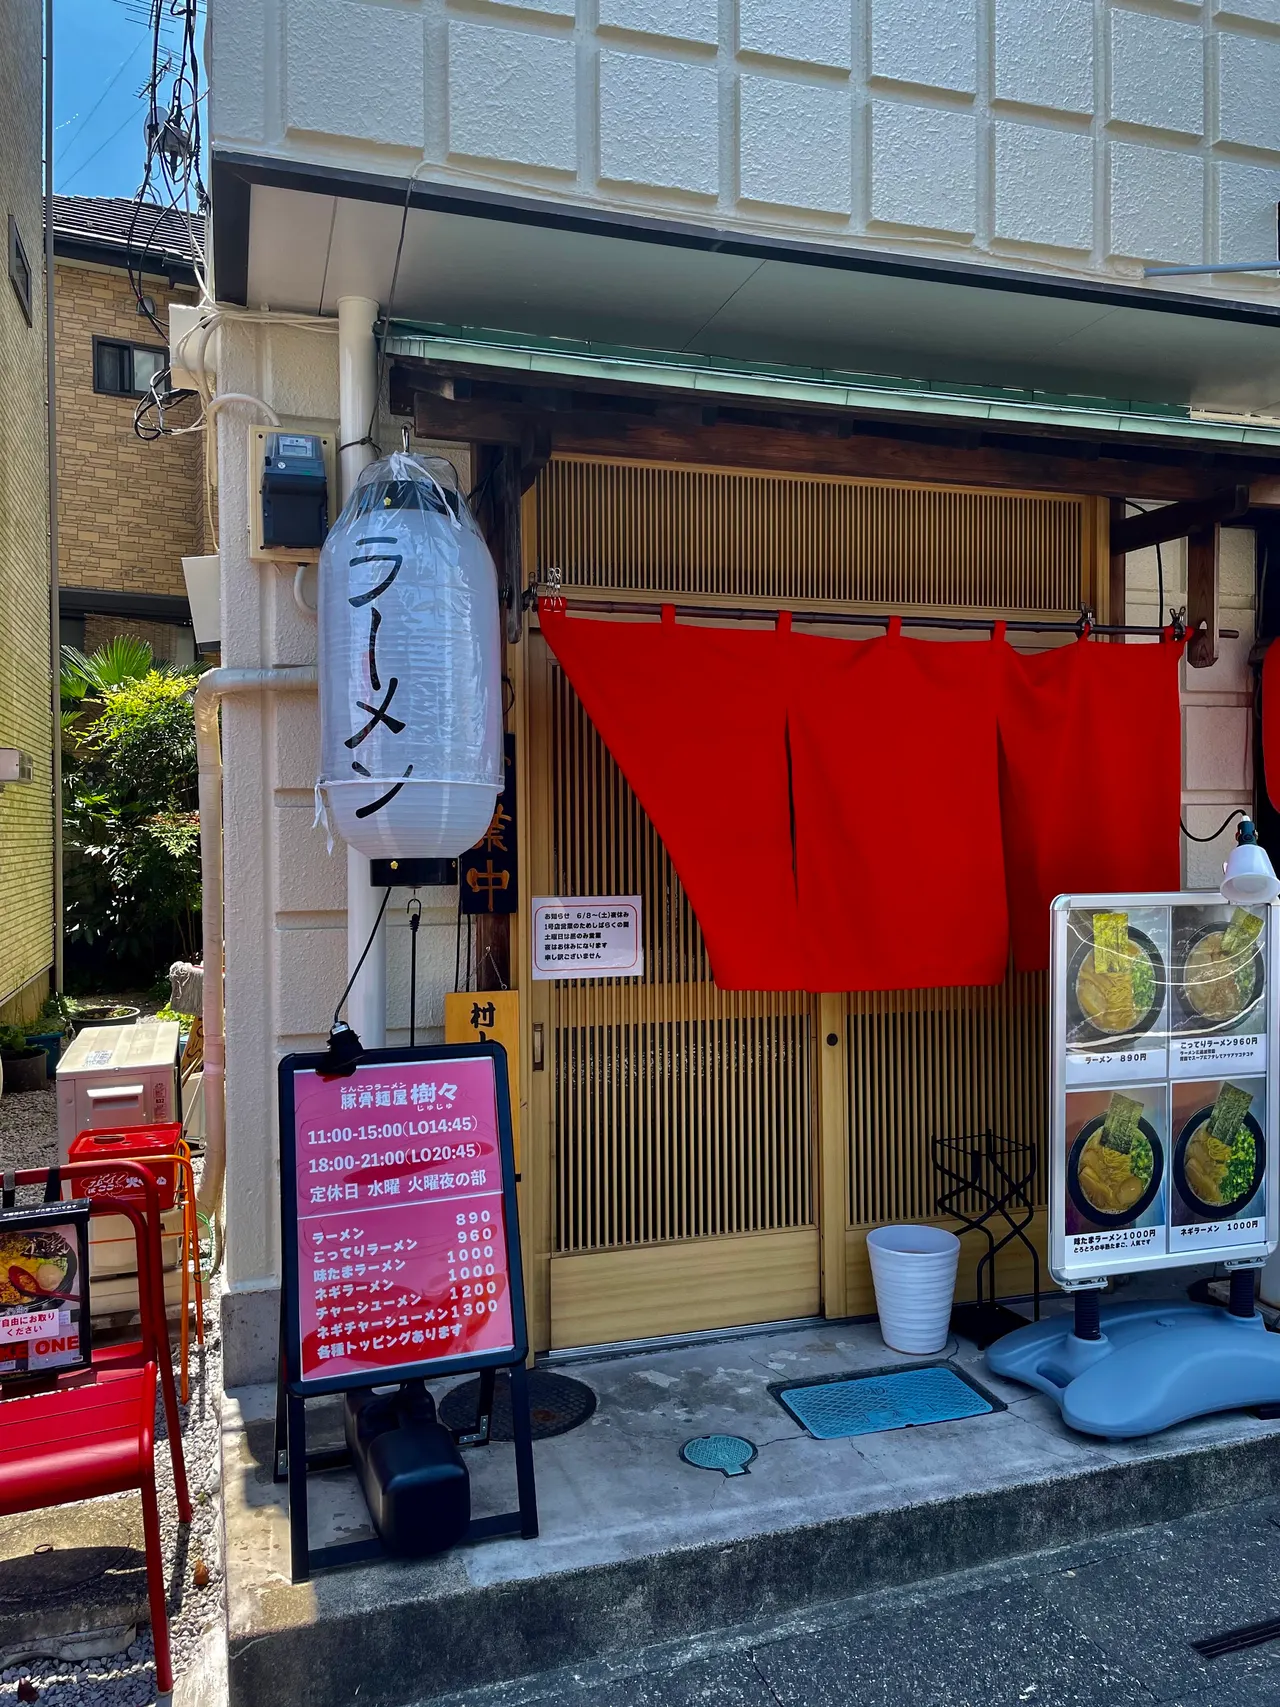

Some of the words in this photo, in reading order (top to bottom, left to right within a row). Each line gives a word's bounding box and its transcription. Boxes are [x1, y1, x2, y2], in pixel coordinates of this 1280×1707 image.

[344, 536, 413, 819] ラーメン
[465, 757, 513, 913] 業中
[544, 912, 570, 920] お知らせ
[544, 942, 608, 951] 夜はお休みになります
[544, 952, 602, 961] 申し訳ございません
[470, 1001, 497, 1043] 村
[1085, 1055, 1113, 1065] ラーメン
[1120, 1053, 1147, 1063] 890円
[340, 1082, 407, 1093] とんこつラーメン
[417, 1103, 453, 1112] じゅじゅ
[310, 1183, 359, 1204] 定休日
[367, 1178, 400, 1197] 水曜
[408, 1169, 487, 1193] 火曜夜の部
[312, 1227, 365, 1245] ラーメン
[455, 1210, 491, 1226] 890
[1180, 1225, 1220, 1236] ネギラーメン
[1227, 1220, 1259, 1231] 1000円
[313, 1238, 418, 1264] こってりラーメン
[457, 1227, 492, 1243] 960
[313, 1258, 406, 1283] 味たまラーメン
[447, 1245, 493, 1264] 1000
[314, 1278, 394, 1301] ネギラーメン
[448, 1263, 495, 1282] 1000
[315, 1293, 422, 1320] チャーシューメン
[450, 1281, 497, 1300] 1200
[2, 1312, 55, 1328] 自由にお取り
[7, 1325, 43, 1337] ください
[316, 1307, 449, 1340] ネギチャーシューメン
[451, 1299, 498, 1319] 1300
[35, 1334, 80, 1356] ONE
[317, 1323, 463, 1359] 各種トッピングあります
